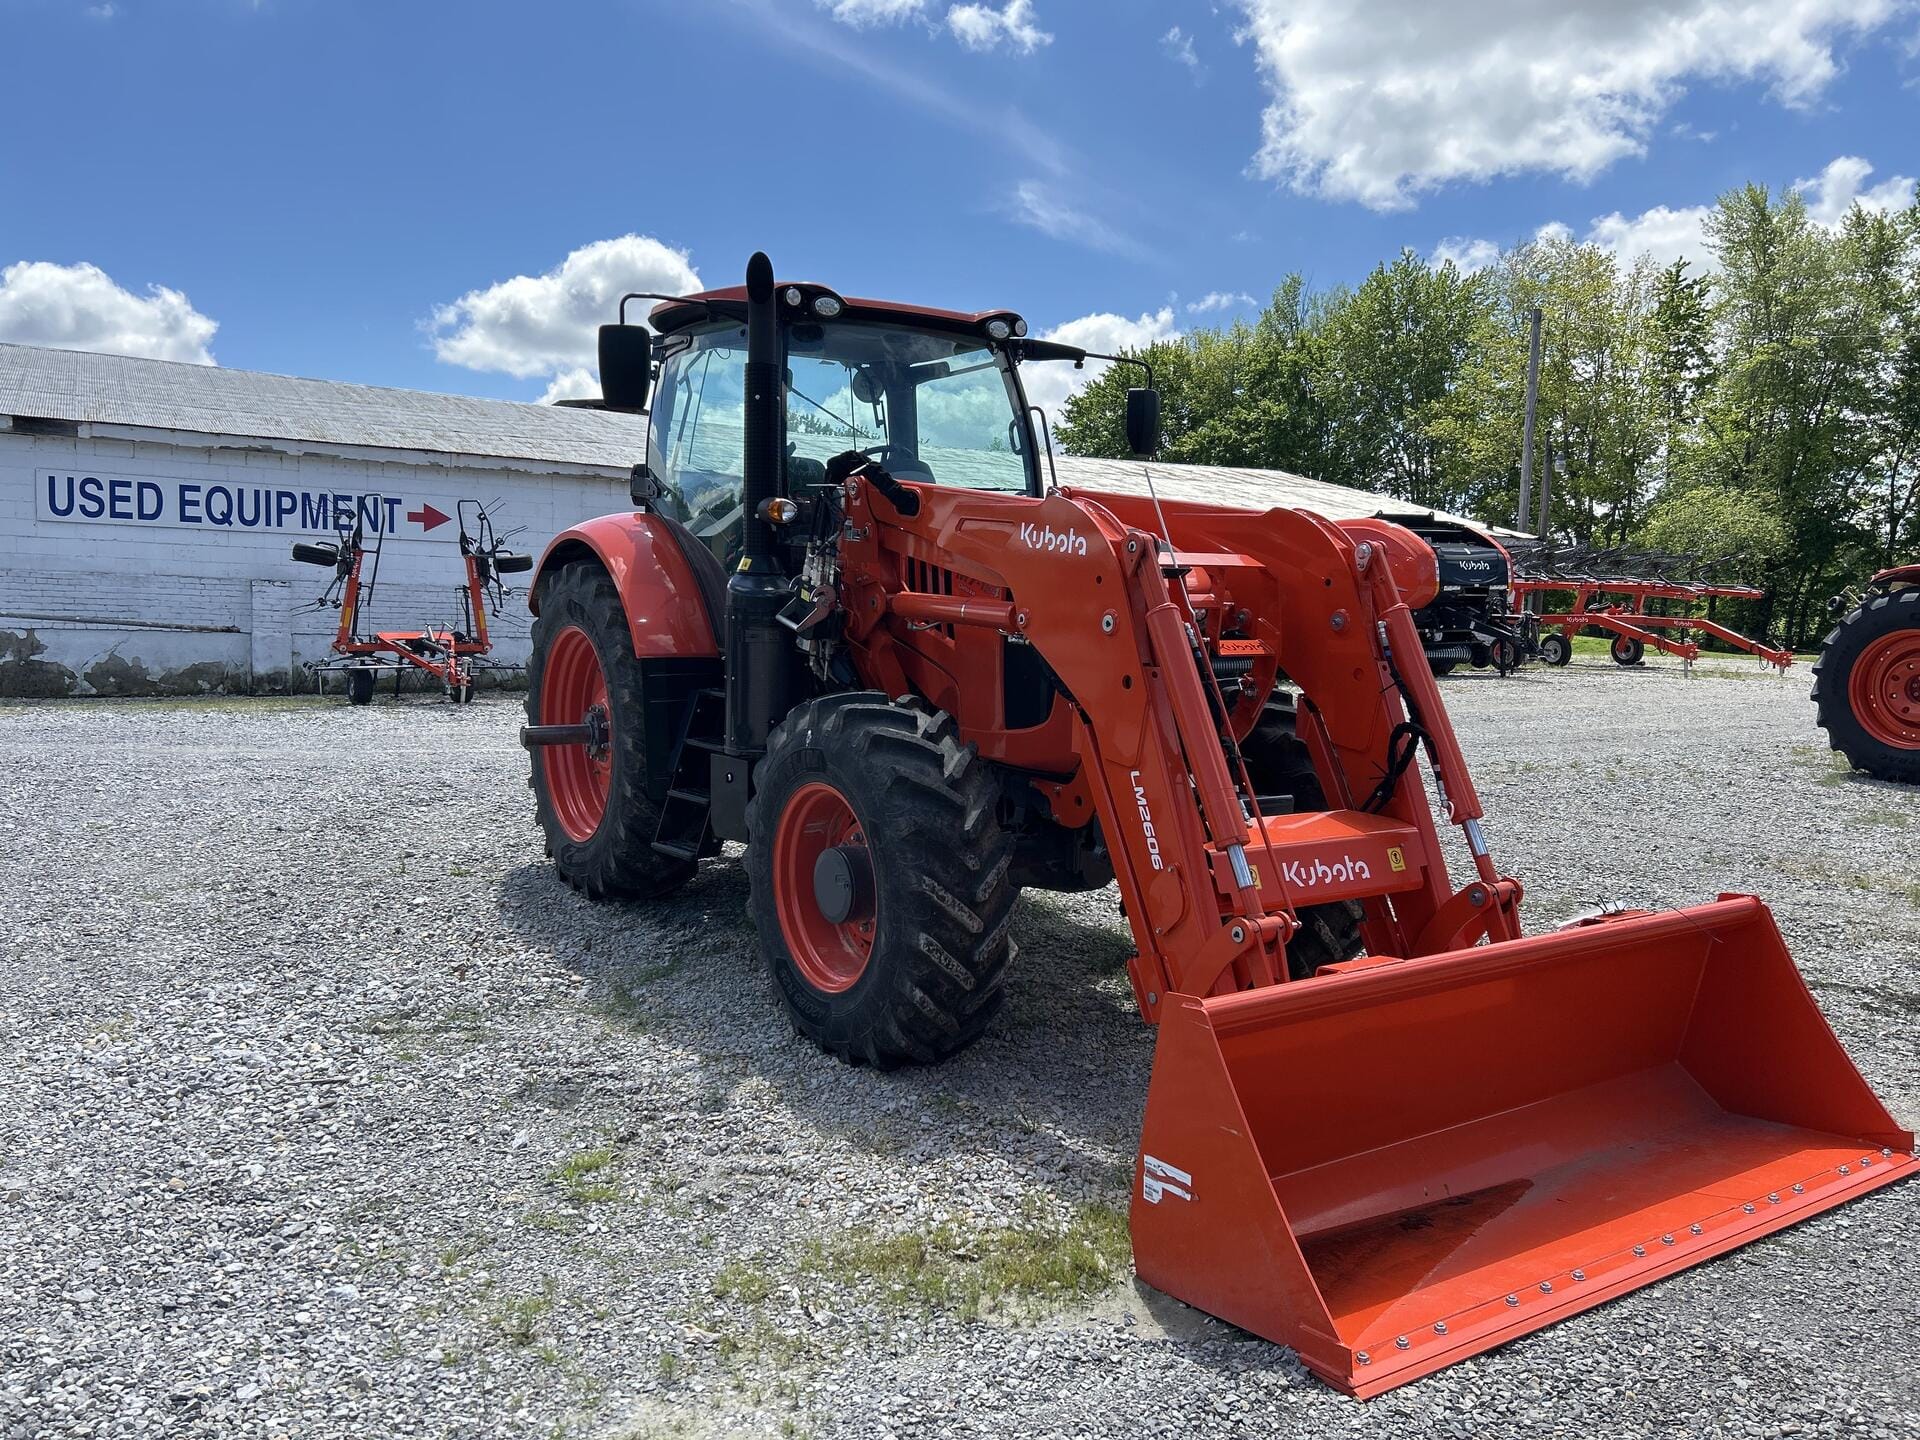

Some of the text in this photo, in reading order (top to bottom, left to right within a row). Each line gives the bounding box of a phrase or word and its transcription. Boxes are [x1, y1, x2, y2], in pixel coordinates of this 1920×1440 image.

[48, 475, 403, 534] USED EQUIPMENT
[1020, 522, 1087, 556] Kubota
[1459, 560, 1491, 571] Kubota
[1130, 770, 1164, 871] LM2606
[1281, 855, 1371, 888] Kubota
